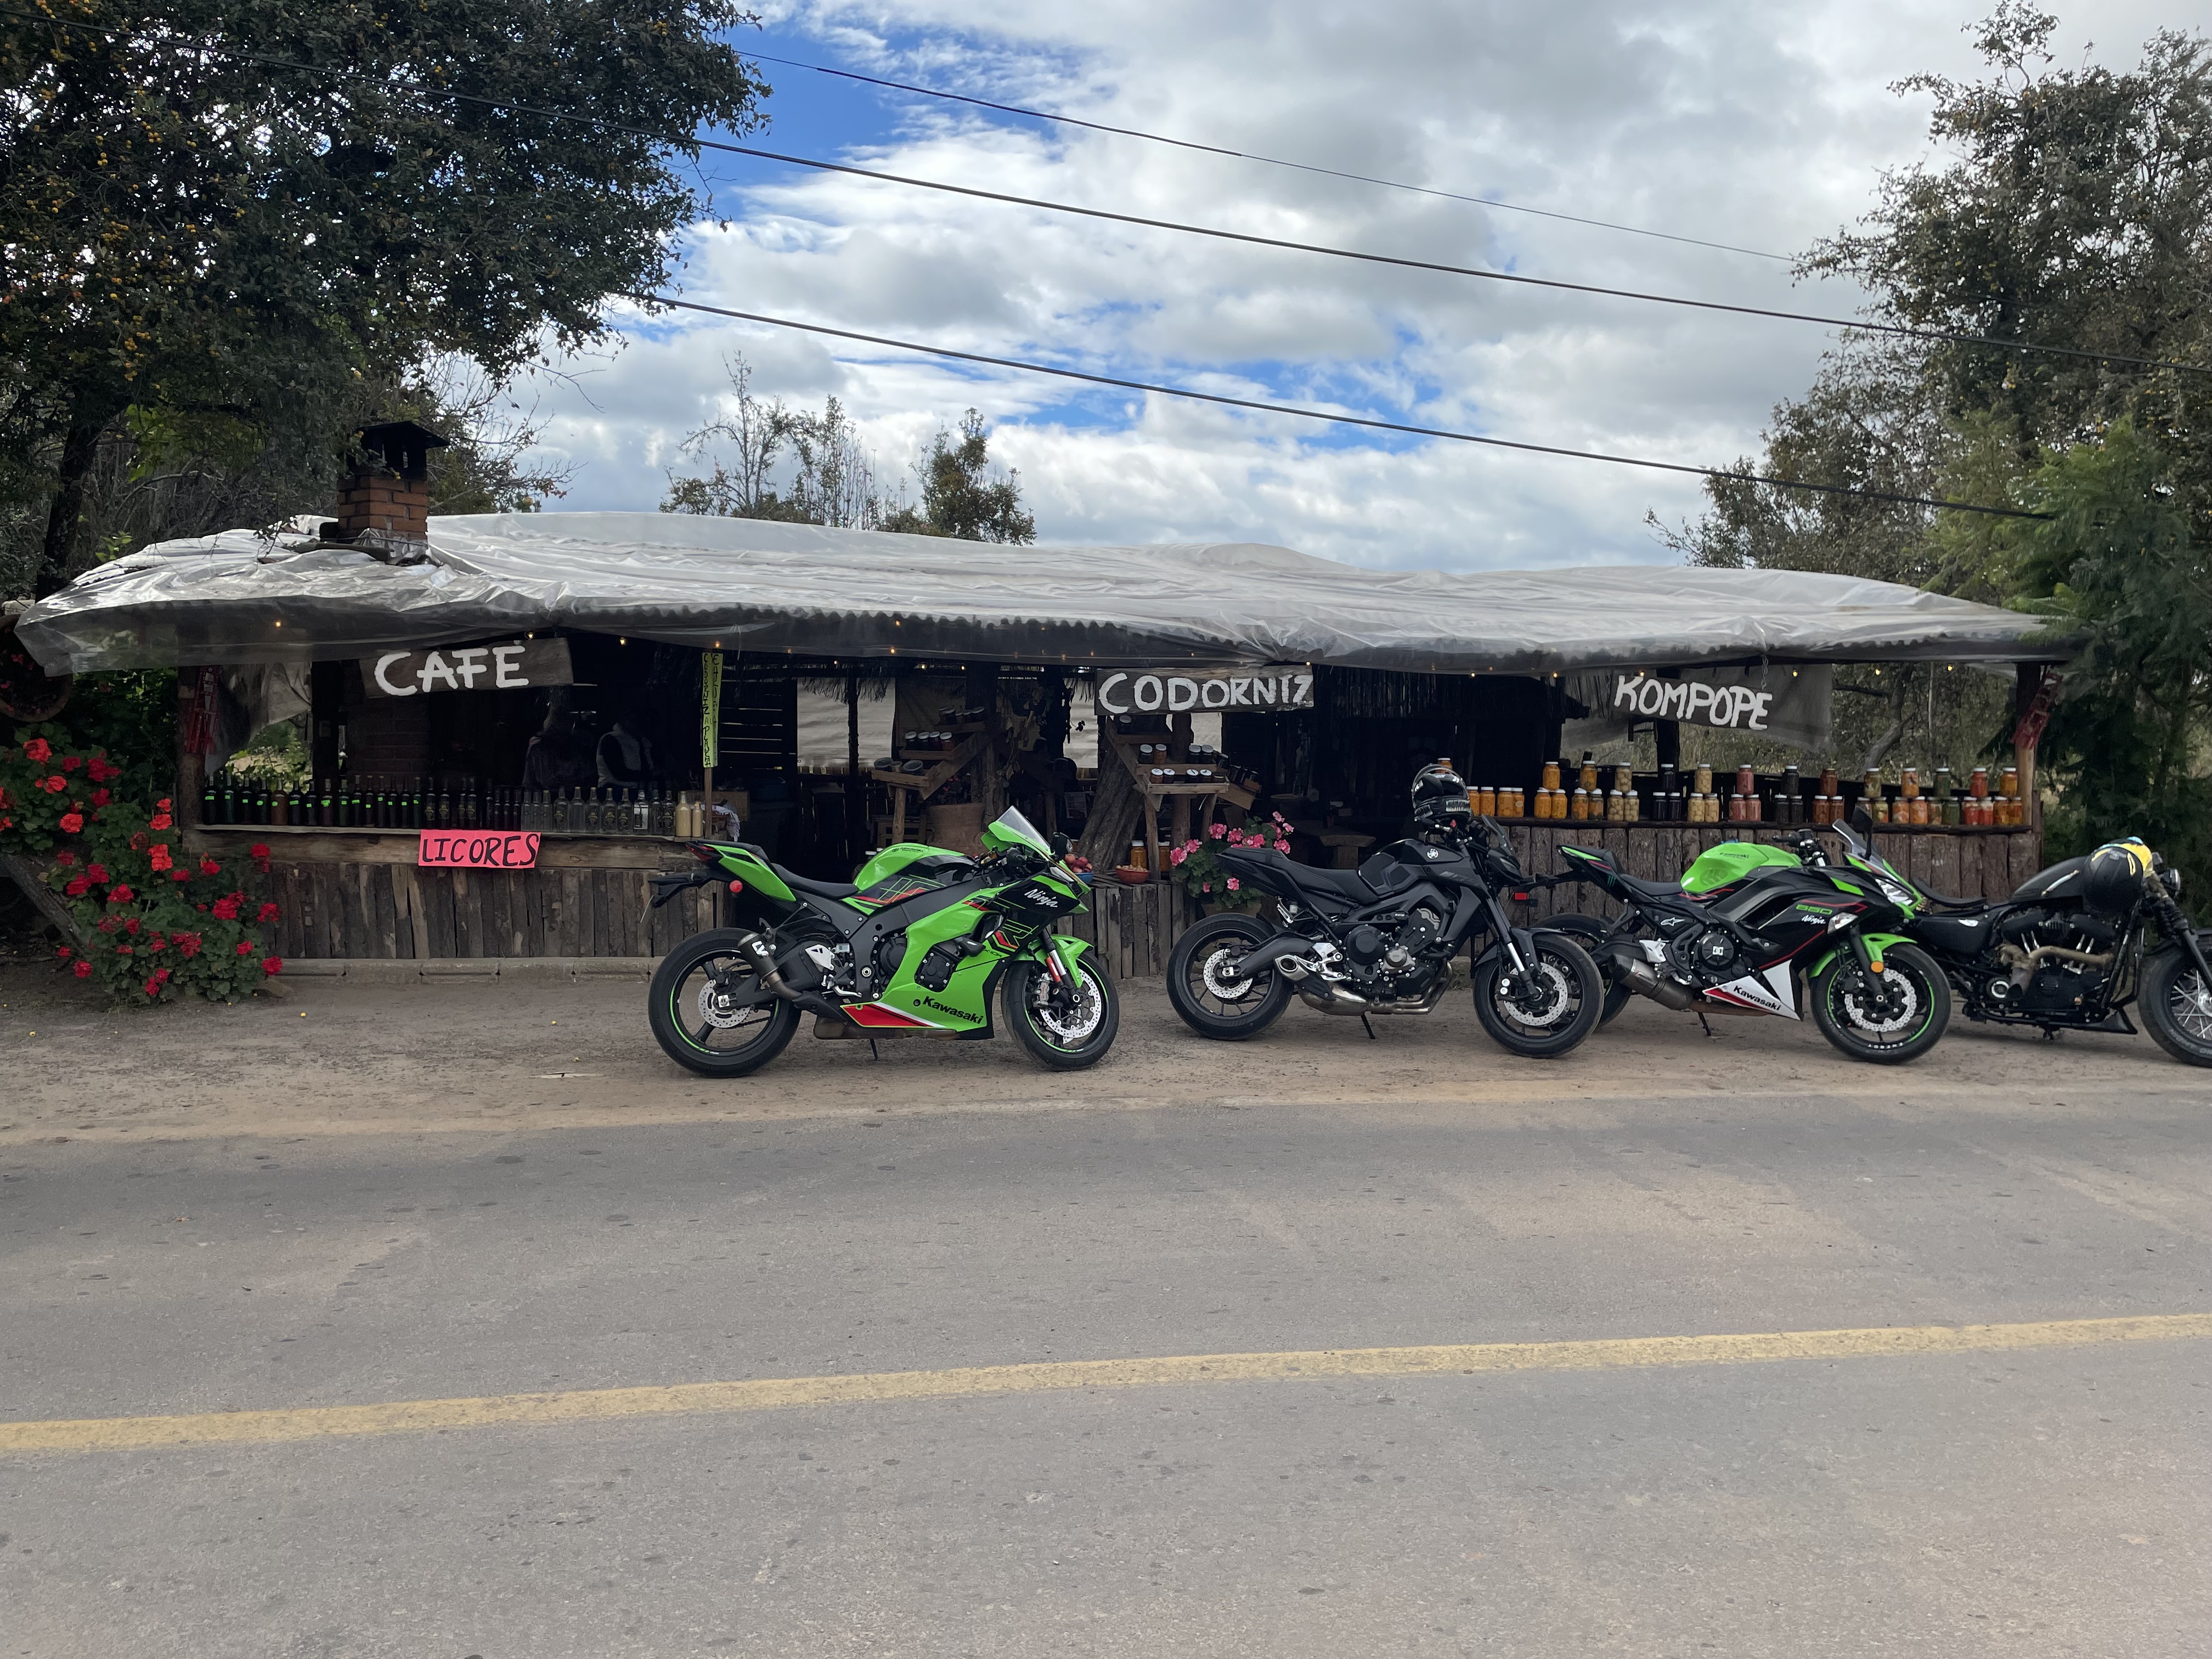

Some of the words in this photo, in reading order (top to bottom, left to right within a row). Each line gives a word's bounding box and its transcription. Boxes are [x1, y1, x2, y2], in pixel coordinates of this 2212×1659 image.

[1614, 675, 1773, 730] KOMPOPE
[422, 833, 539, 867] LICORES
[1024, 888, 1058, 908] Ninja
[1801, 915, 1826, 925] Ninja
[922, 996, 984, 1024] Kawasaki
[1733, 985, 1782, 1011] Kawasaki
